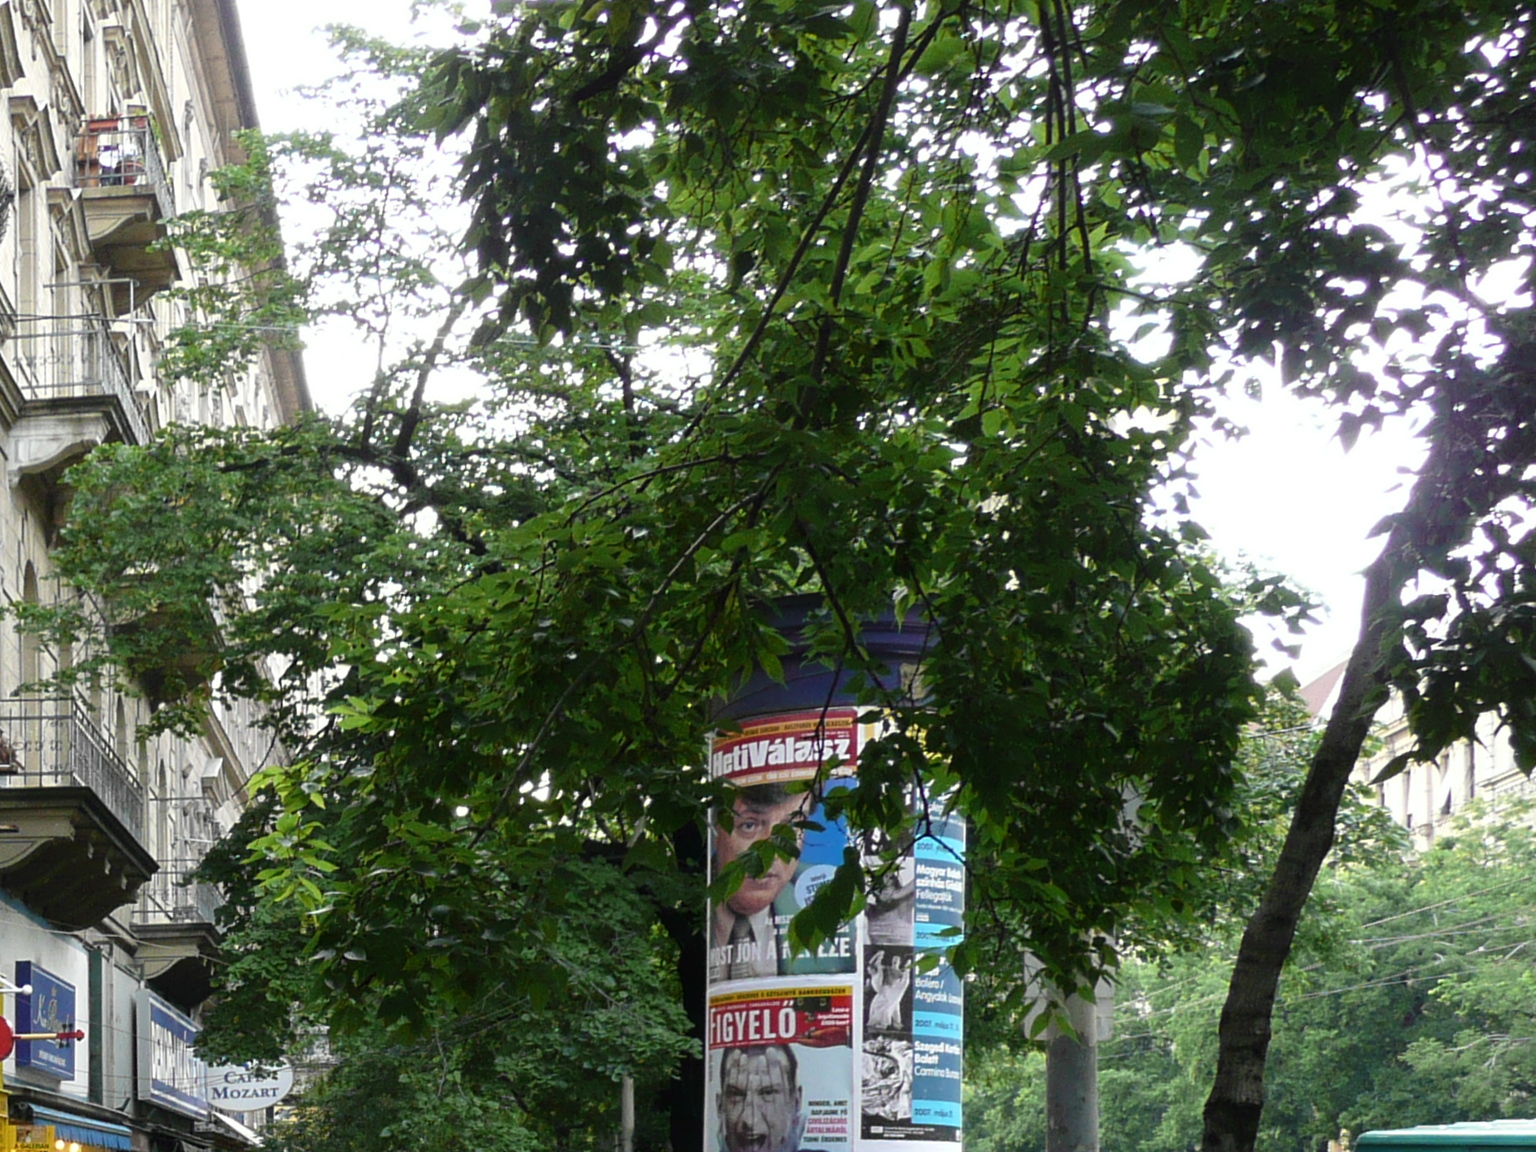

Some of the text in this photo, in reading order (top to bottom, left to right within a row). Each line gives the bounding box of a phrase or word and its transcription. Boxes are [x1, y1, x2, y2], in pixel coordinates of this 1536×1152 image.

[712, 736, 851, 781] HetiVálasz
[710, 999, 796, 1045] FIGYELŐ
[211, 1086, 279, 1100] MOZART
